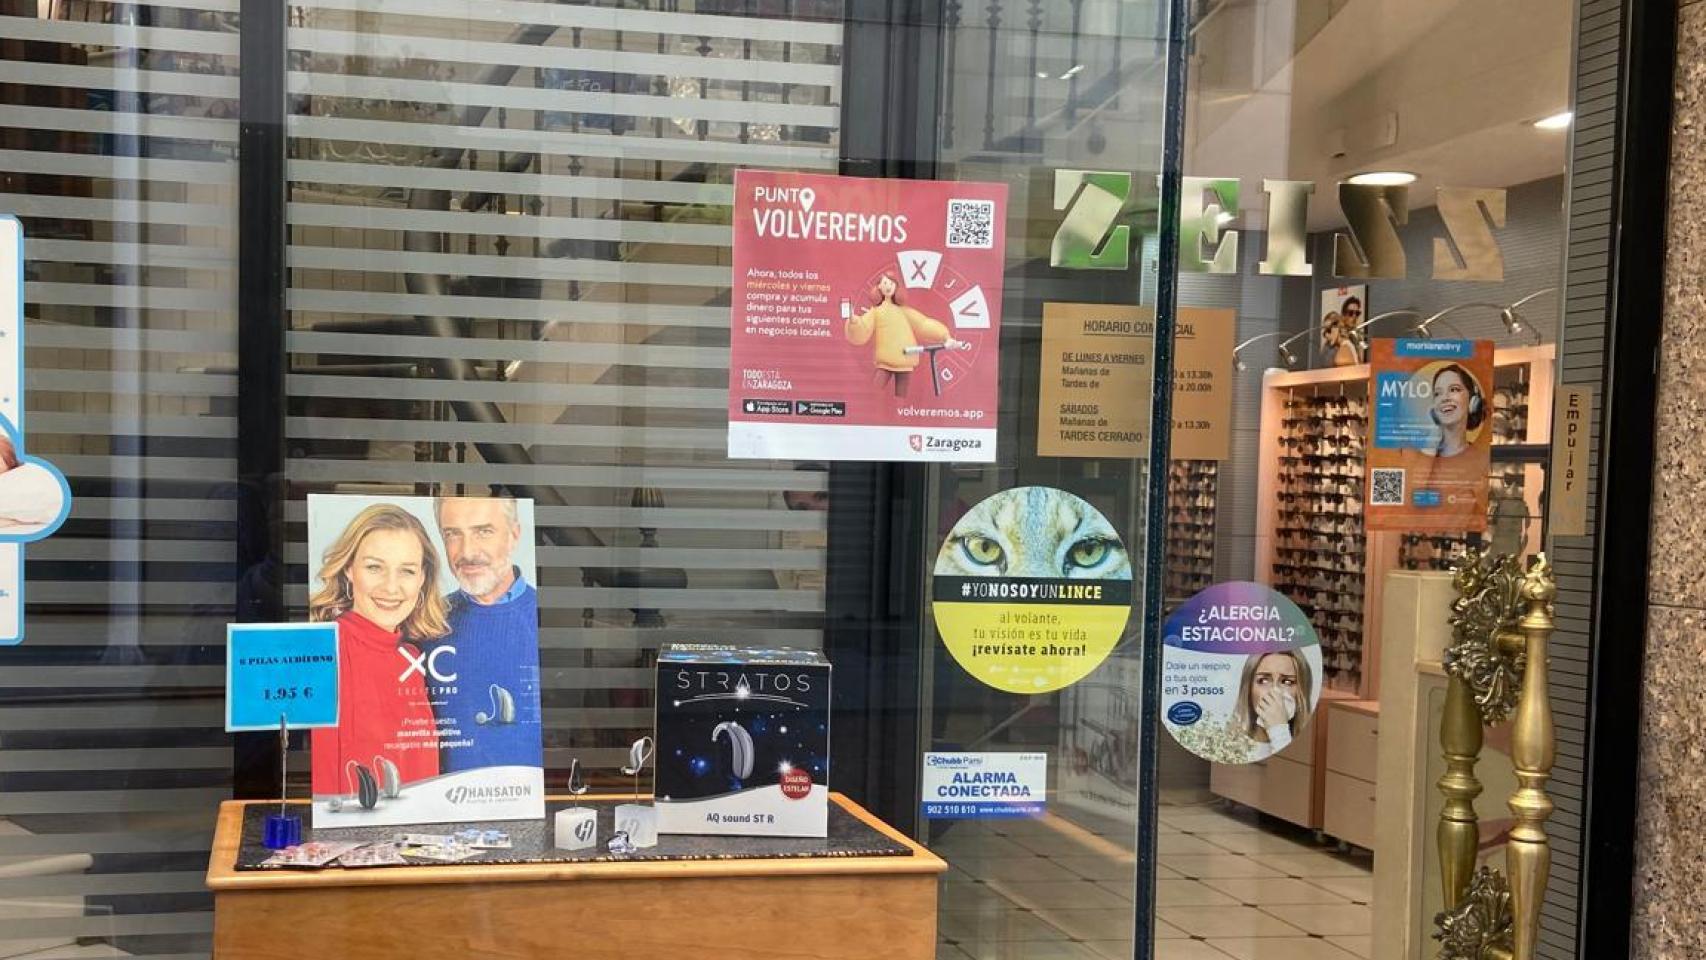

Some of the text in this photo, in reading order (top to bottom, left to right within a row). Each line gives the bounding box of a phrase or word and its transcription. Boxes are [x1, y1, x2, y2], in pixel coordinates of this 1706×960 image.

[753, 207, 908, 244] VOLVEREMOS
[1051, 168, 1507, 280] ZEISS
[747, 267, 818, 280] Ahora, todos los
[801, 283, 831, 292] viernes
[746, 293, 828, 303] compra y acumula
[746, 302, 812, 314] dinero para tus
[746, 314, 831, 327] siguientes compras
[1083, 320, 1130, 333] HORARIO
[759, 326, 797, 337] negocios
[1062, 352, 1073, 362] DE
[1075, 352, 1101, 362] LUNES
[1111, 354, 1145, 364] VIERNES
[1062, 366, 1110, 376] Mañanas de
[1062, 379, 1099, 389] Tardes de
[1381, 380, 1431, 398] MYLO
[897, 405, 984, 420] volveremos.app
[1060, 417, 1096, 426] Mañanas
[1059, 431, 1142, 442] TARDES CERRADO
[1566, 394, 1582, 491] Empujar
[926, 436, 982, 452] Zaragoza
[961, 583, 1102, 599] #YONOSOYUNLINCE
[1000, 611, 1061, 625] al volante,
[1198, 605, 1280, 624] ¿ALERGIA
[973, 627, 1086, 640] tu visión es tu vida
[1182, 626, 1295, 642] ESTACIONAL?
[1040, 645, 1086, 657] ahora!
[398, 645, 458, 683] XC
[1188, 663, 1200, 671] un
[1201, 662, 1231, 672] respiro
[677, 671, 811, 691] STRATOS
[1173, 674, 1188, 682] tus
[1165, 685, 1224, 697] en 3 pasos
[937, 756, 963, 765] Chubb
[952, 772, 1017, 783] ALARMA
[468, 785, 531, 798] HANSATON
[937, 785, 1031, 797] CONECTADA
[927, 805, 942, 814] 902
[945, 805, 959, 814] 510
[707, 813, 775, 824] AQ sound ST R
